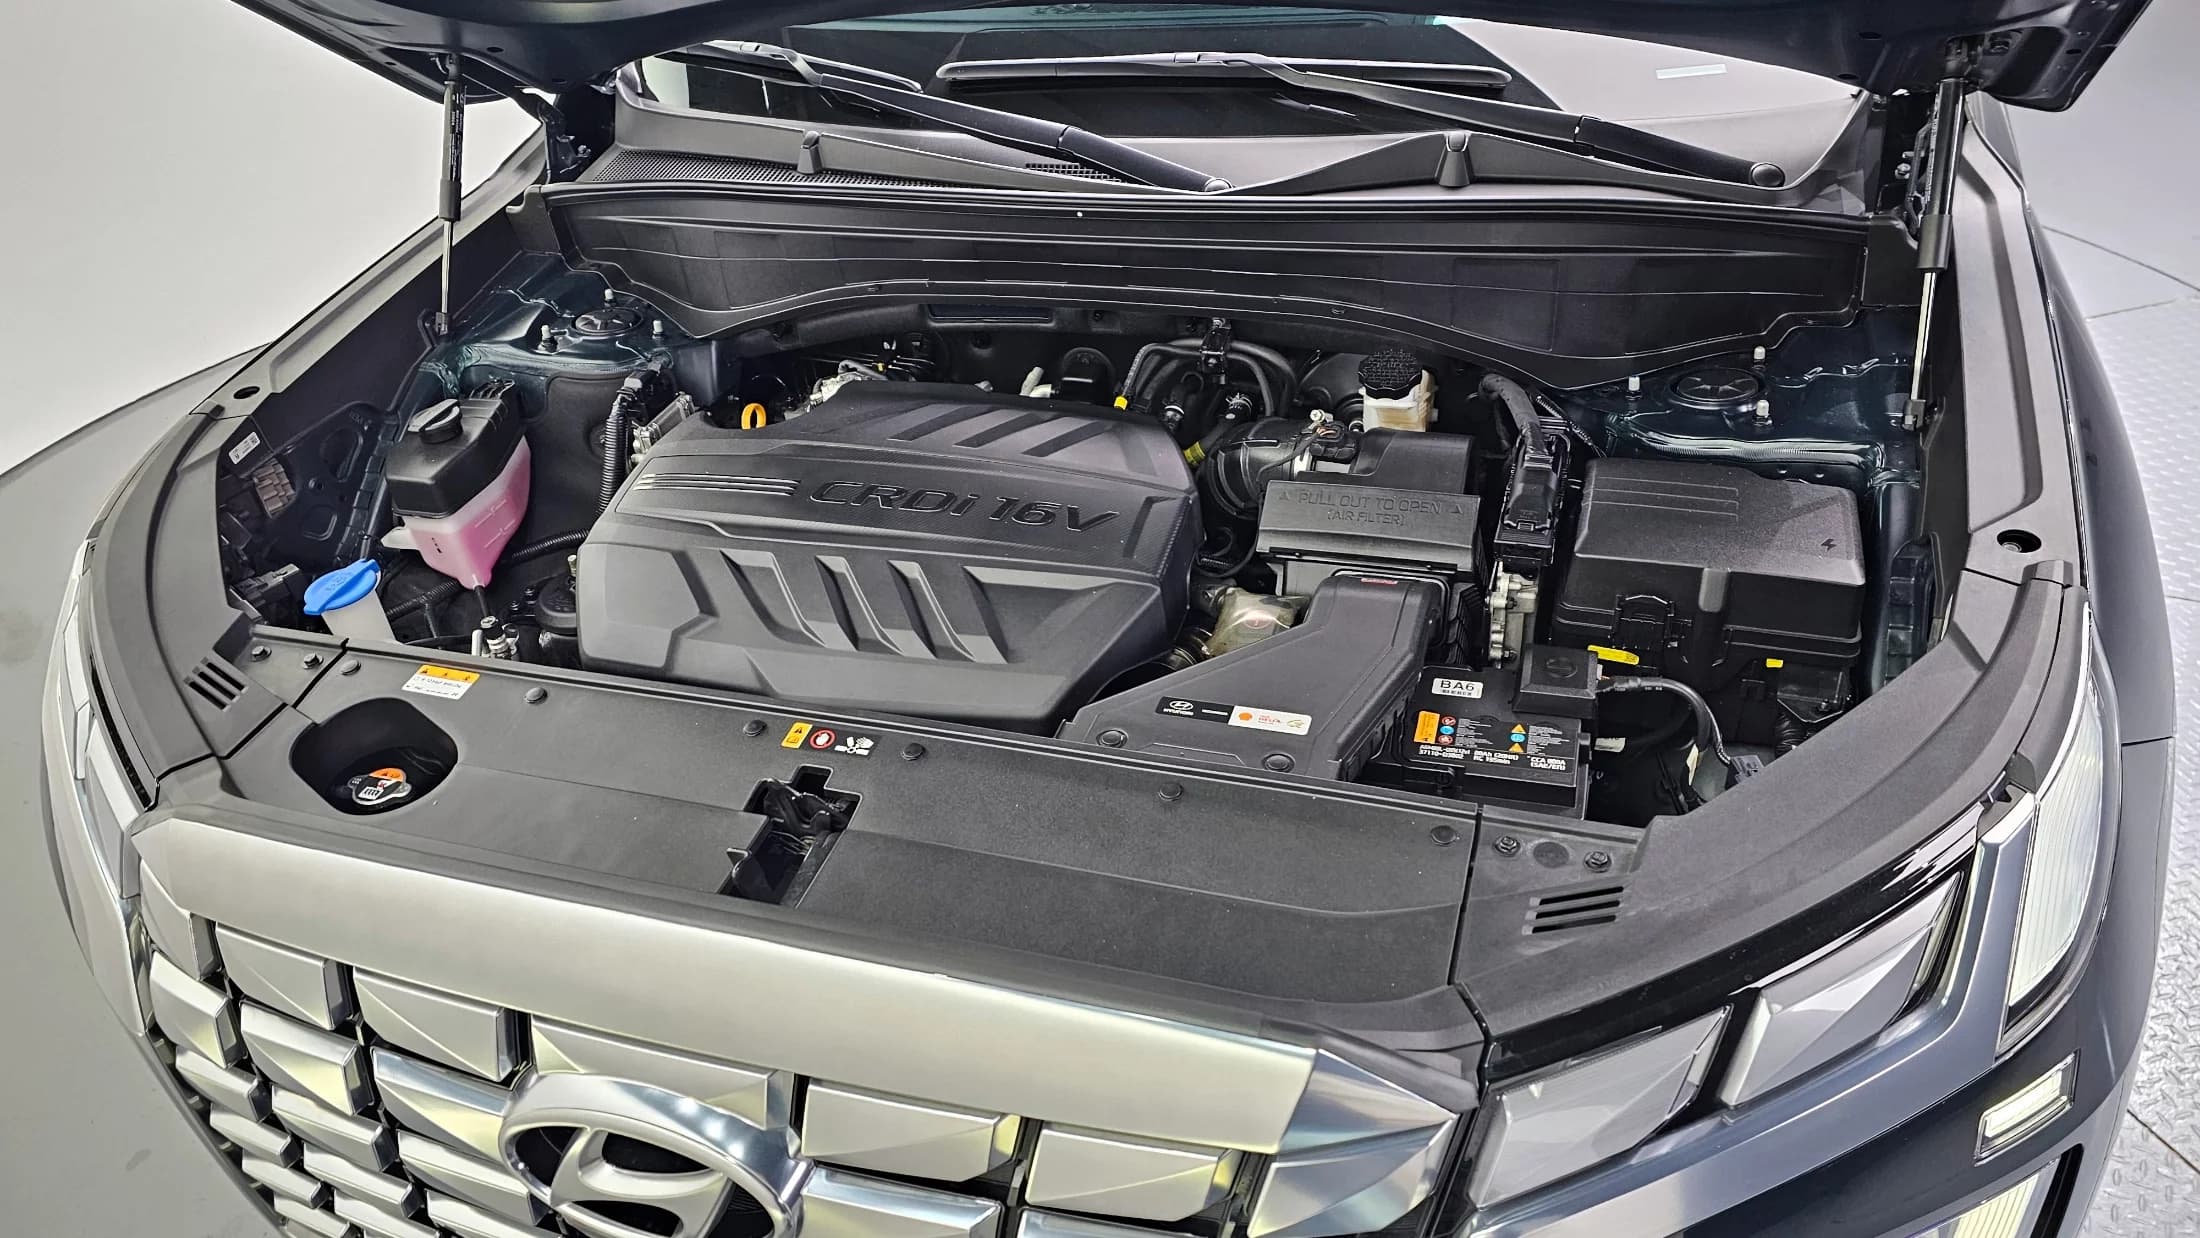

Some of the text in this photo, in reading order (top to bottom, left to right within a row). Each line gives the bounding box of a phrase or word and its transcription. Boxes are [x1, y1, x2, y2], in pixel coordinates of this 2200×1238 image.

[810, 480, 1120, 532] CRDi 16V
[1298, 489, 1441, 515] PULL OUT TO OPEN
[1327, 509, 1406, 527] (AIR FILTER)
[1440, 680, 1474, 691] BA6
